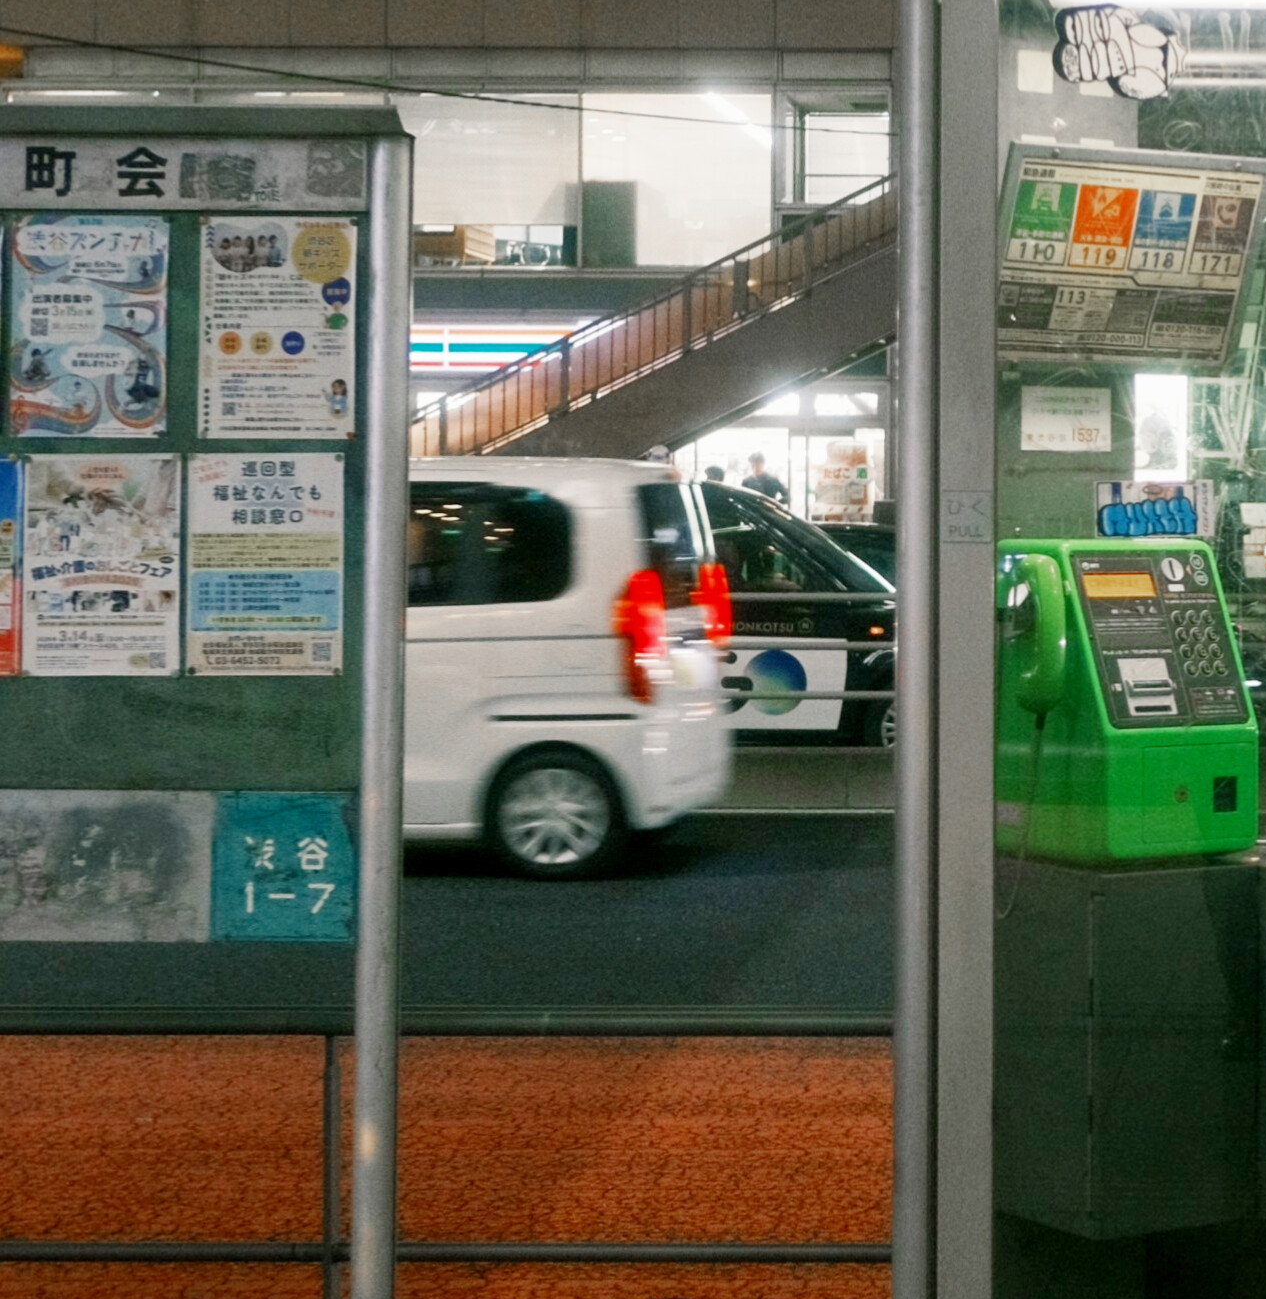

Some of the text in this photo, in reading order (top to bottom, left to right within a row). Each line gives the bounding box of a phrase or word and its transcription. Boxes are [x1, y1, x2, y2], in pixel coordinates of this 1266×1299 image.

[1019, 242, 1055, 261] 110
[1082, 246, 1117, 265] 119
[1142, 251, 1174, 269] 118
[1201, 255, 1232, 273] 171
[1058, 290, 1086, 304] 113
[242, 461, 295, 477] 巡回型
[213, 485, 321, 501] 福祉なんでも
[232, 508, 303, 524] 相談窓口
[949, 525, 984, 537] PULL
[735, 621, 794, 633] ONKOTSU
[245, 881, 335, 914] 1-7
